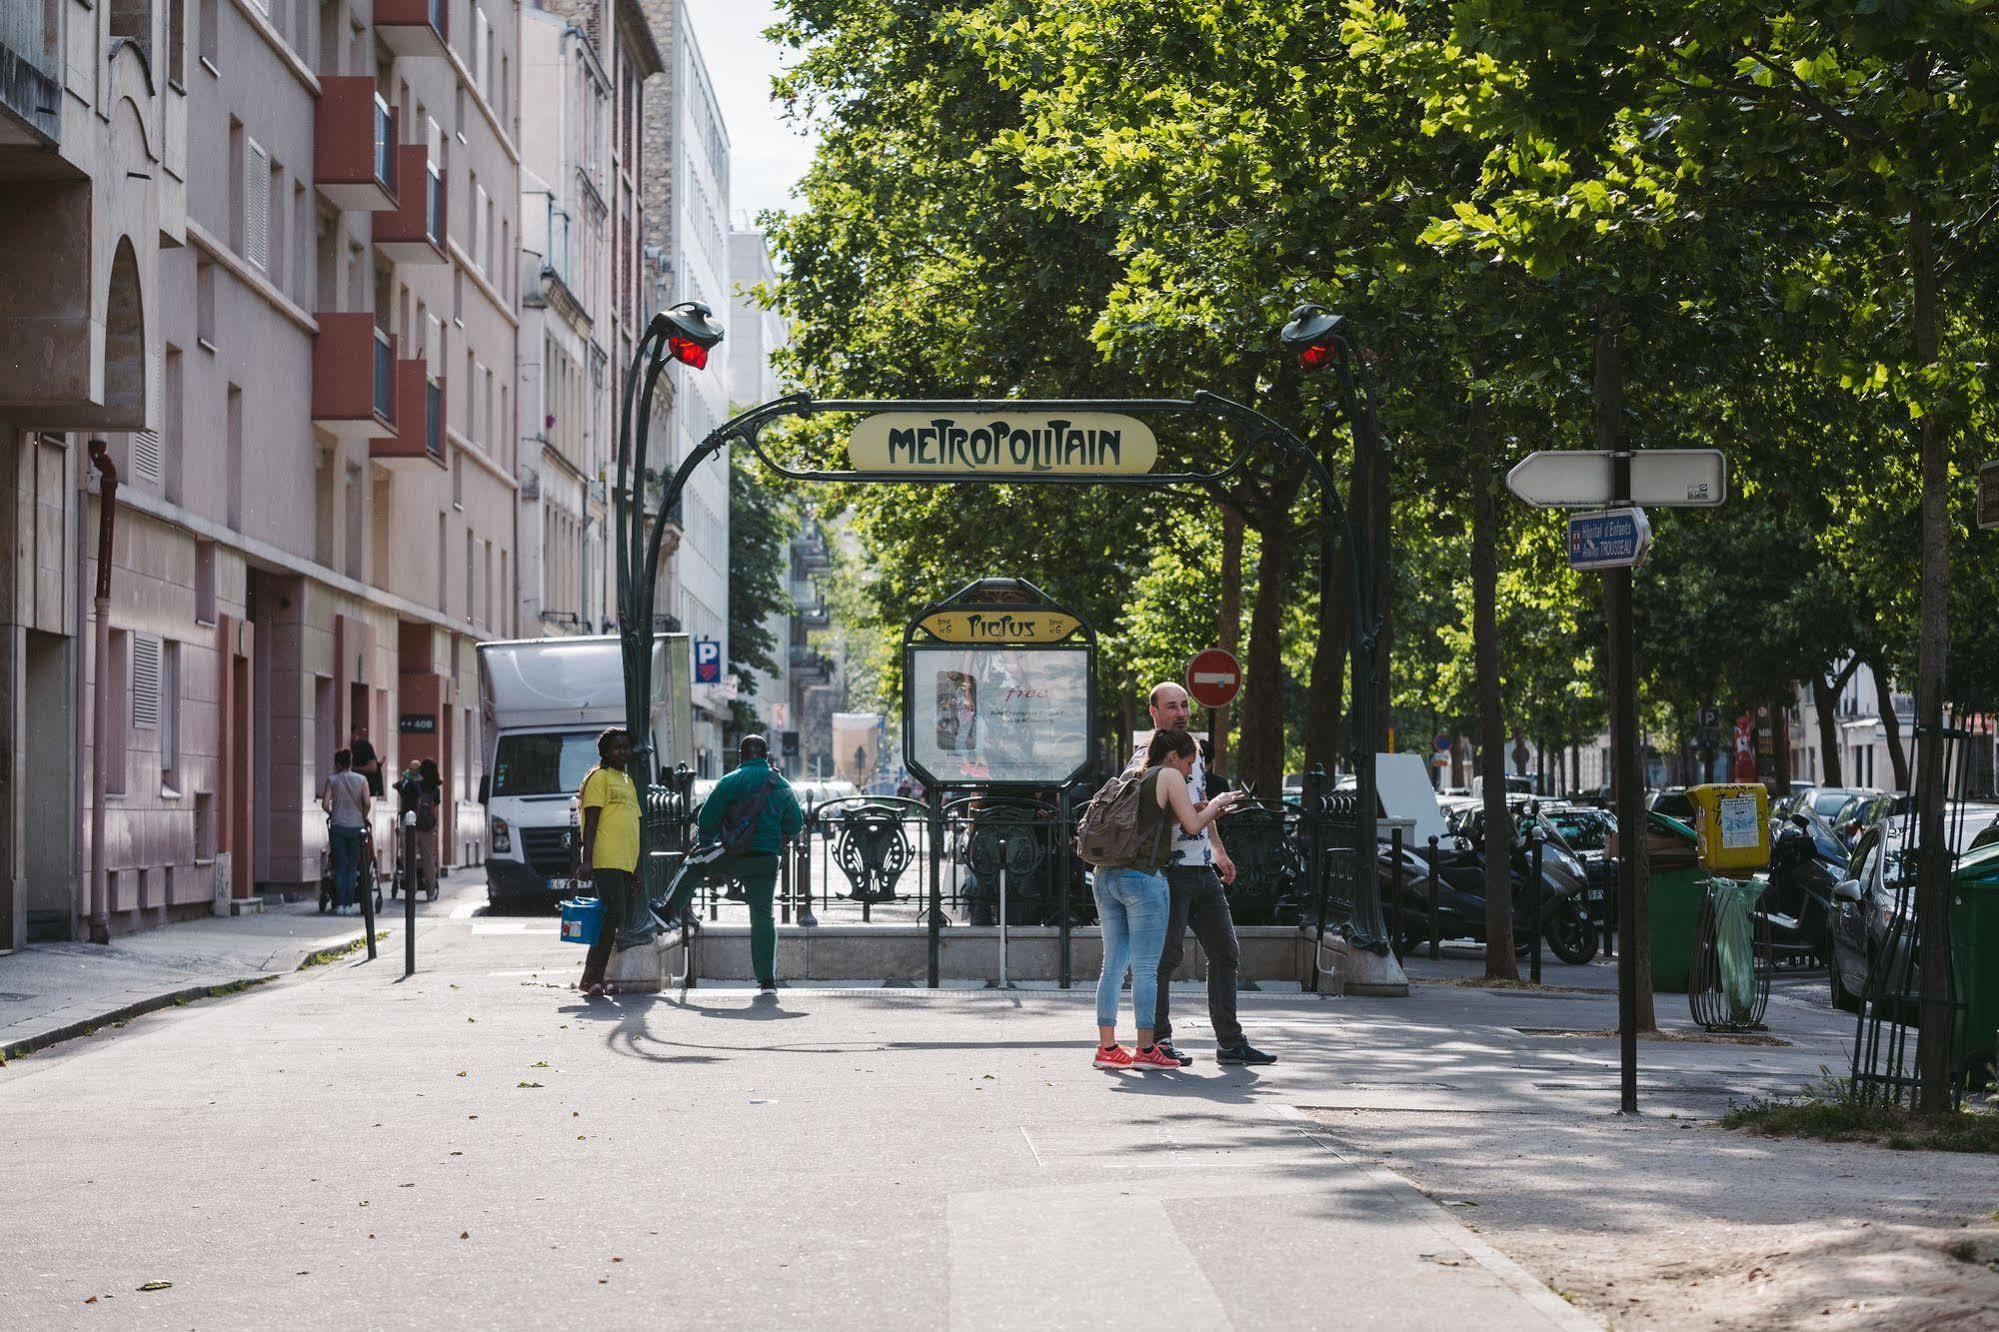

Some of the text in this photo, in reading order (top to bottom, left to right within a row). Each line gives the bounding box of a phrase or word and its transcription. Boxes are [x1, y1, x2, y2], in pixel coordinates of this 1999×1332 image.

[888, 419, 1121, 471] METROPOLITAIN
[1605, 520, 1632, 537] d'Enfants
[1600, 539, 1632, 556] TROUSSEAU
[698, 643, 718, 664] P
